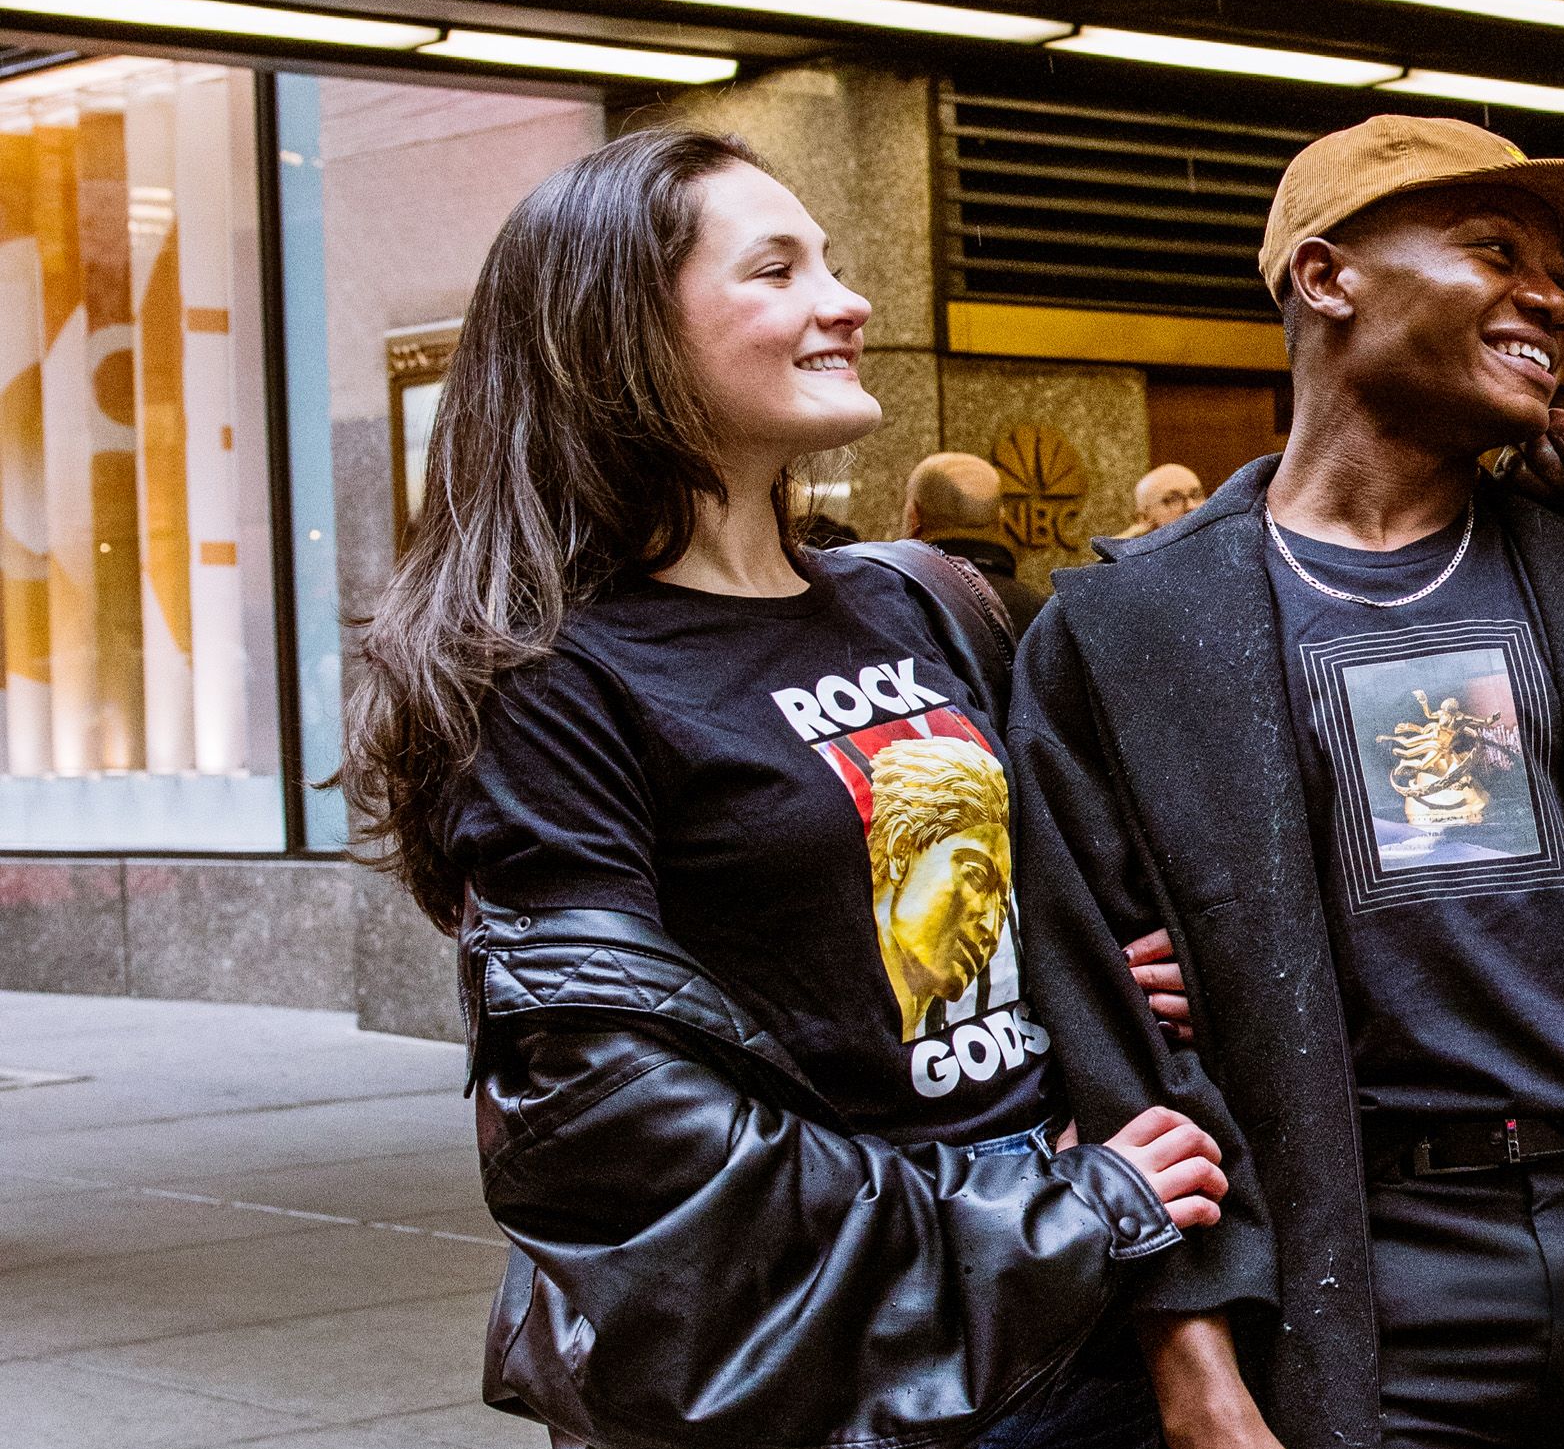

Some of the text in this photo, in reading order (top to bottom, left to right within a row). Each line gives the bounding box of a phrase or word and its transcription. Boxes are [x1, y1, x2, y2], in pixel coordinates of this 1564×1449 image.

[1001, 501, 1080, 552] NBC
[770, 657, 949, 742] ROCK
[910, 1001, 1051, 1098] GODS
